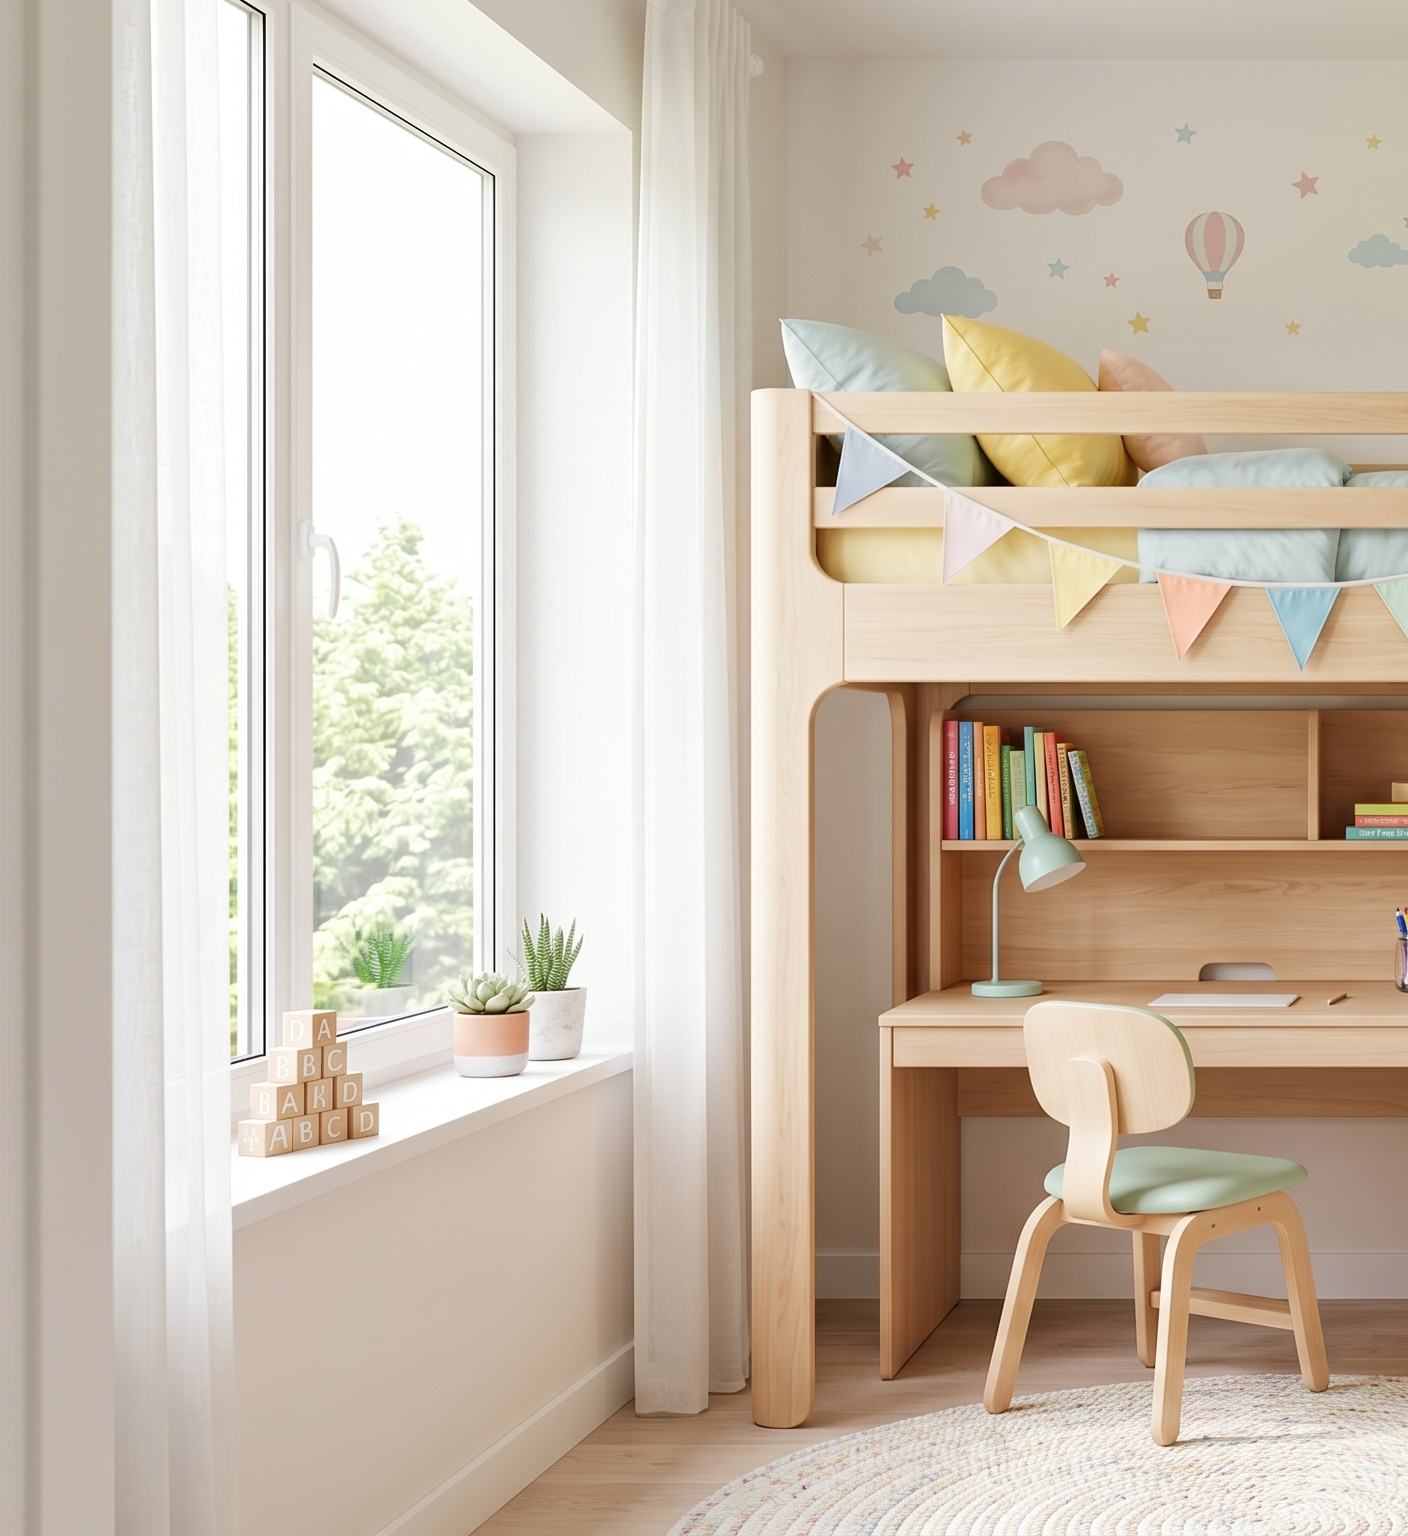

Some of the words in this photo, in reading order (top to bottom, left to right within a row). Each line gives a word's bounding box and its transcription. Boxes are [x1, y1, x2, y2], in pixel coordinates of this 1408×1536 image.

[290, 1020, 304, 1042] D
[317, 1018, 331, 1041] A
[276, 1056, 290, 1078] B
[303, 1054, 315, 1077] B
[327, 1049, 342, 1072] C
[259, 1092, 271, 1115] B
[281, 1092, 298, 1114] A
[343, 1081, 358, 1103] D
[269, 1124, 289, 1151] A
[299, 1121, 313, 1143] B
[327, 1116, 341, 1138] C
[360, 1111, 374, 1133] D
